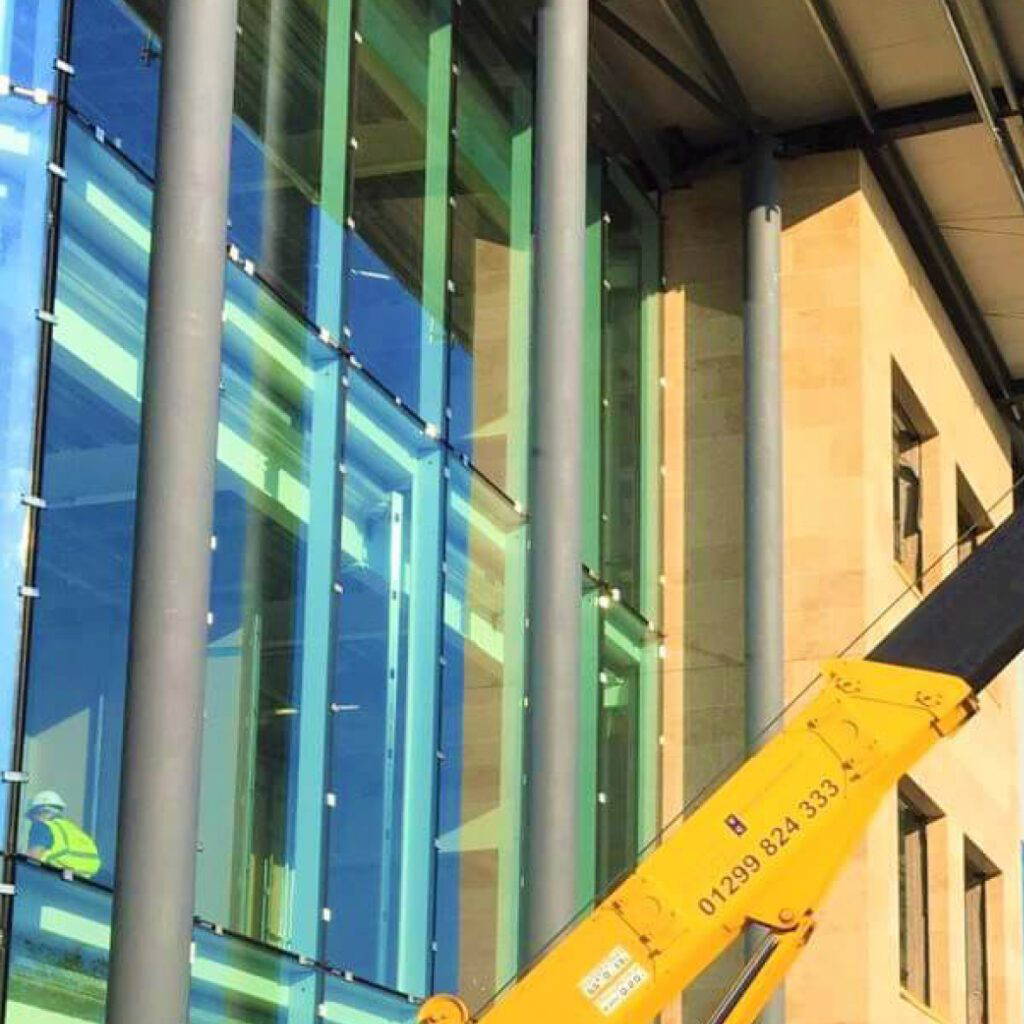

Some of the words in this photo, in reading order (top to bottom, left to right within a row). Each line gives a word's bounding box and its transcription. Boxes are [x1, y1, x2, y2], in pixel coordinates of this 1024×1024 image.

[698, 854, 761, 916] 01299
[760, 816, 800, 856] 824
[798, 778, 840, 819] 333
